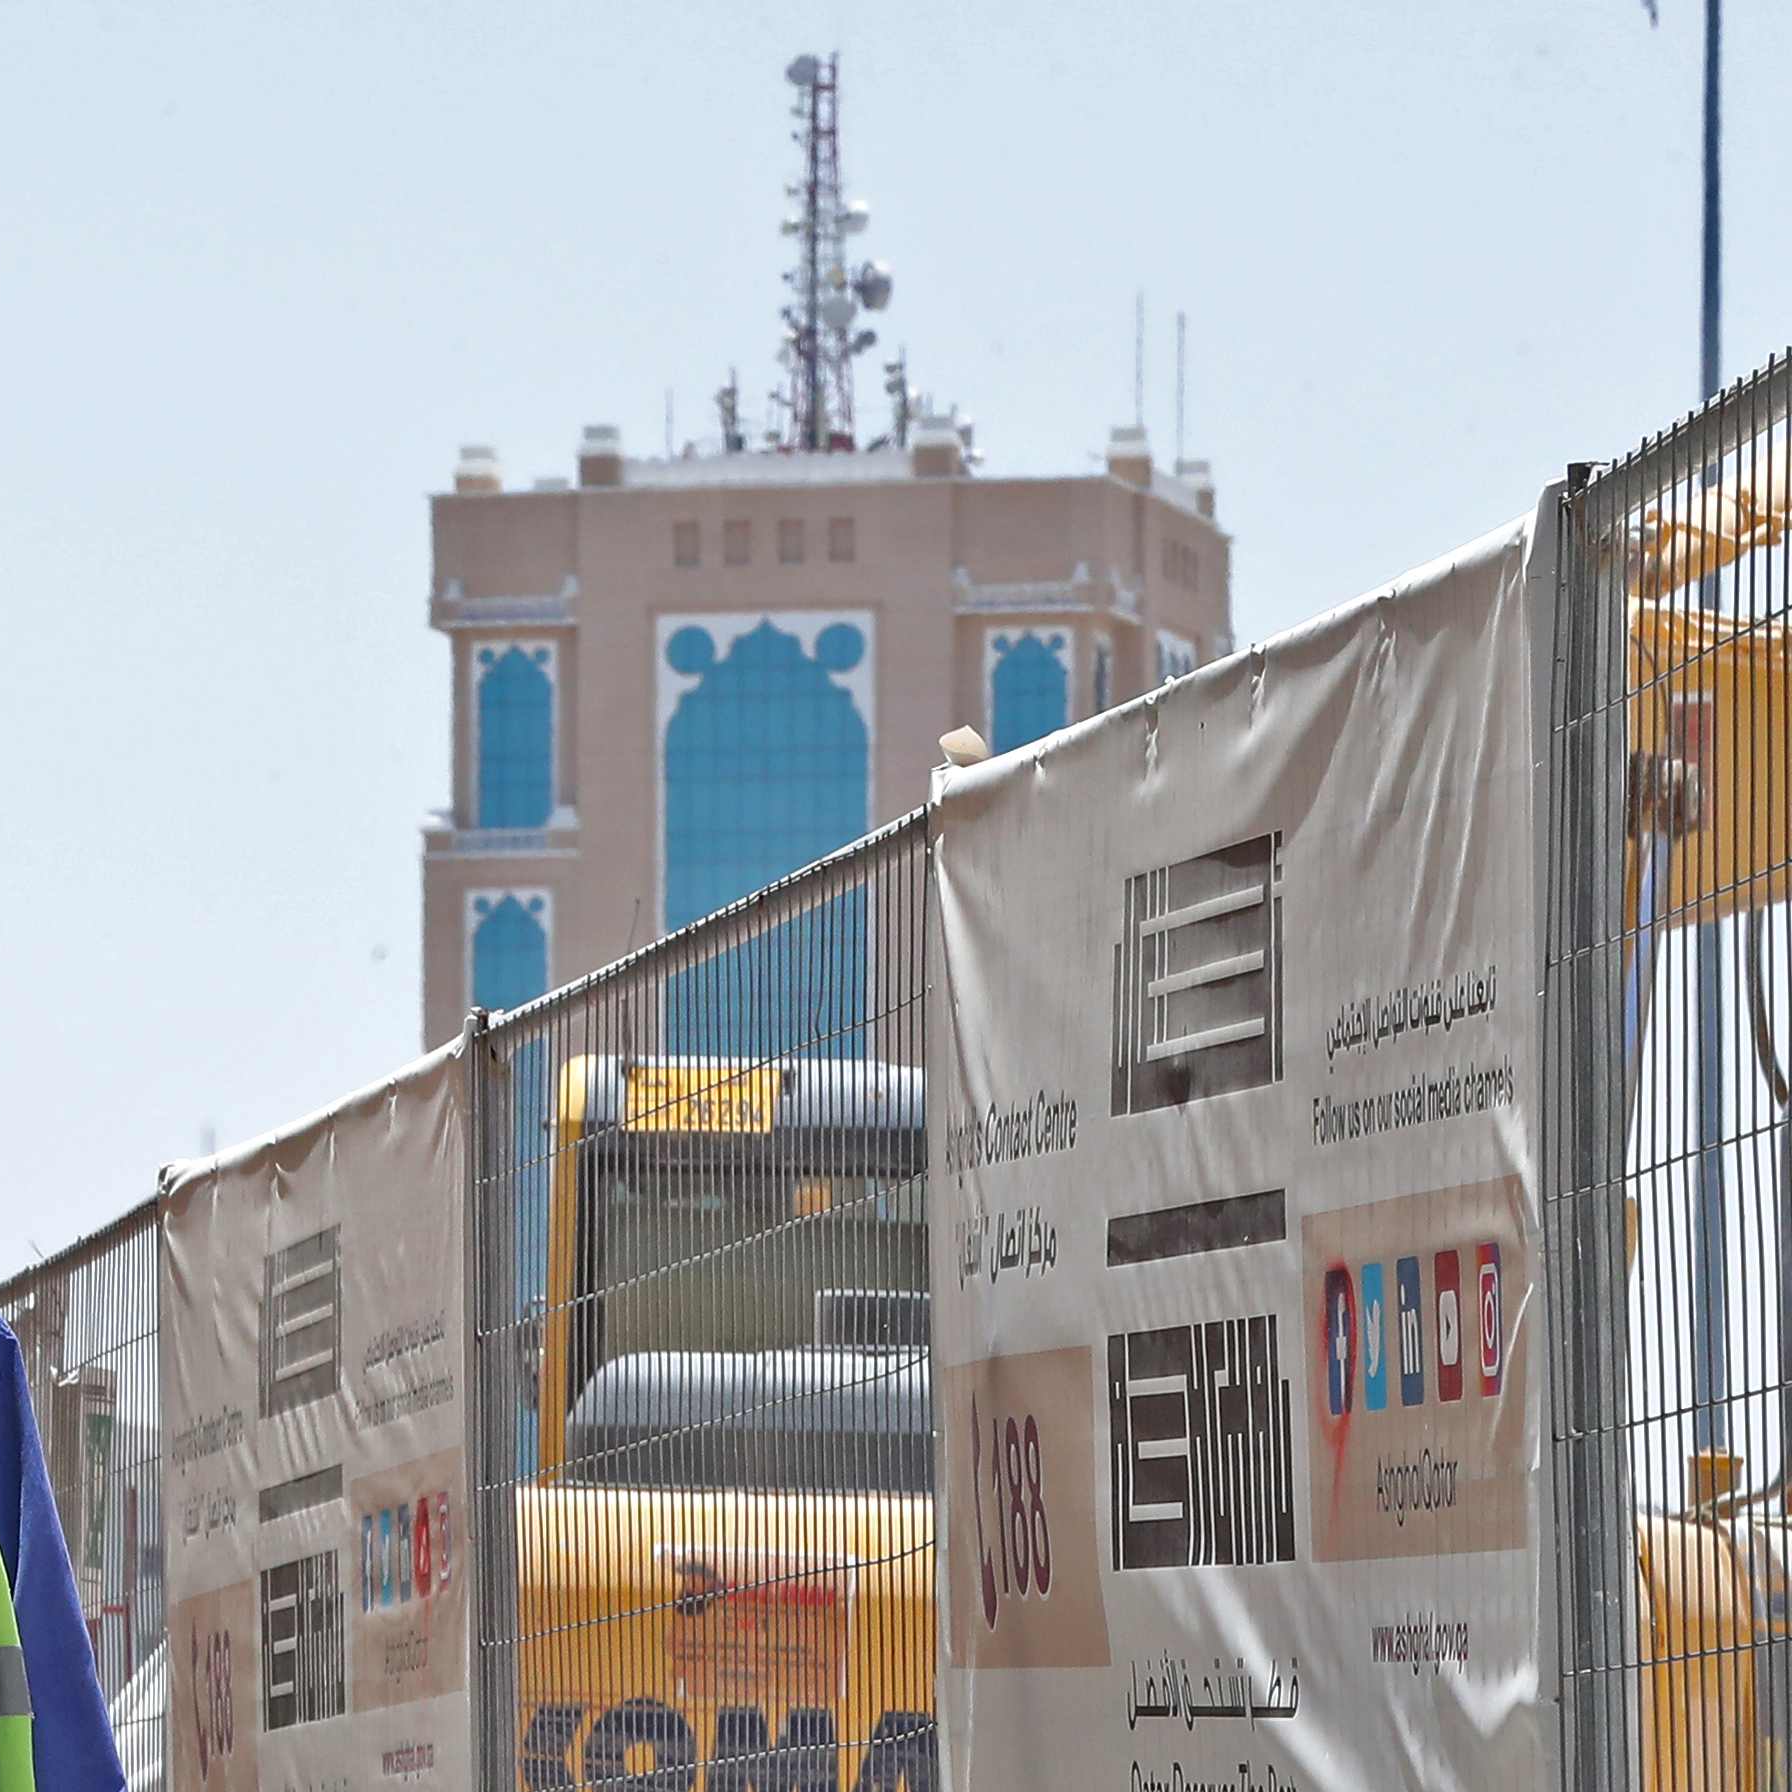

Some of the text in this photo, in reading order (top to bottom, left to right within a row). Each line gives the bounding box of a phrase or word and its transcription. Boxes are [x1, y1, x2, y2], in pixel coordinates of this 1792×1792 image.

[985, 1096, 1033, 1166] Contact
[1035, 1088, 1078, 1155] Centre
[1312, 1052, 1514, 1146] Follow us on our social media channels
[991, 1414, 1052, 1596] 188
[1181, 1657, 1246, 1731] تستحق
[1250, 1657, 1299, 1732] قطر
